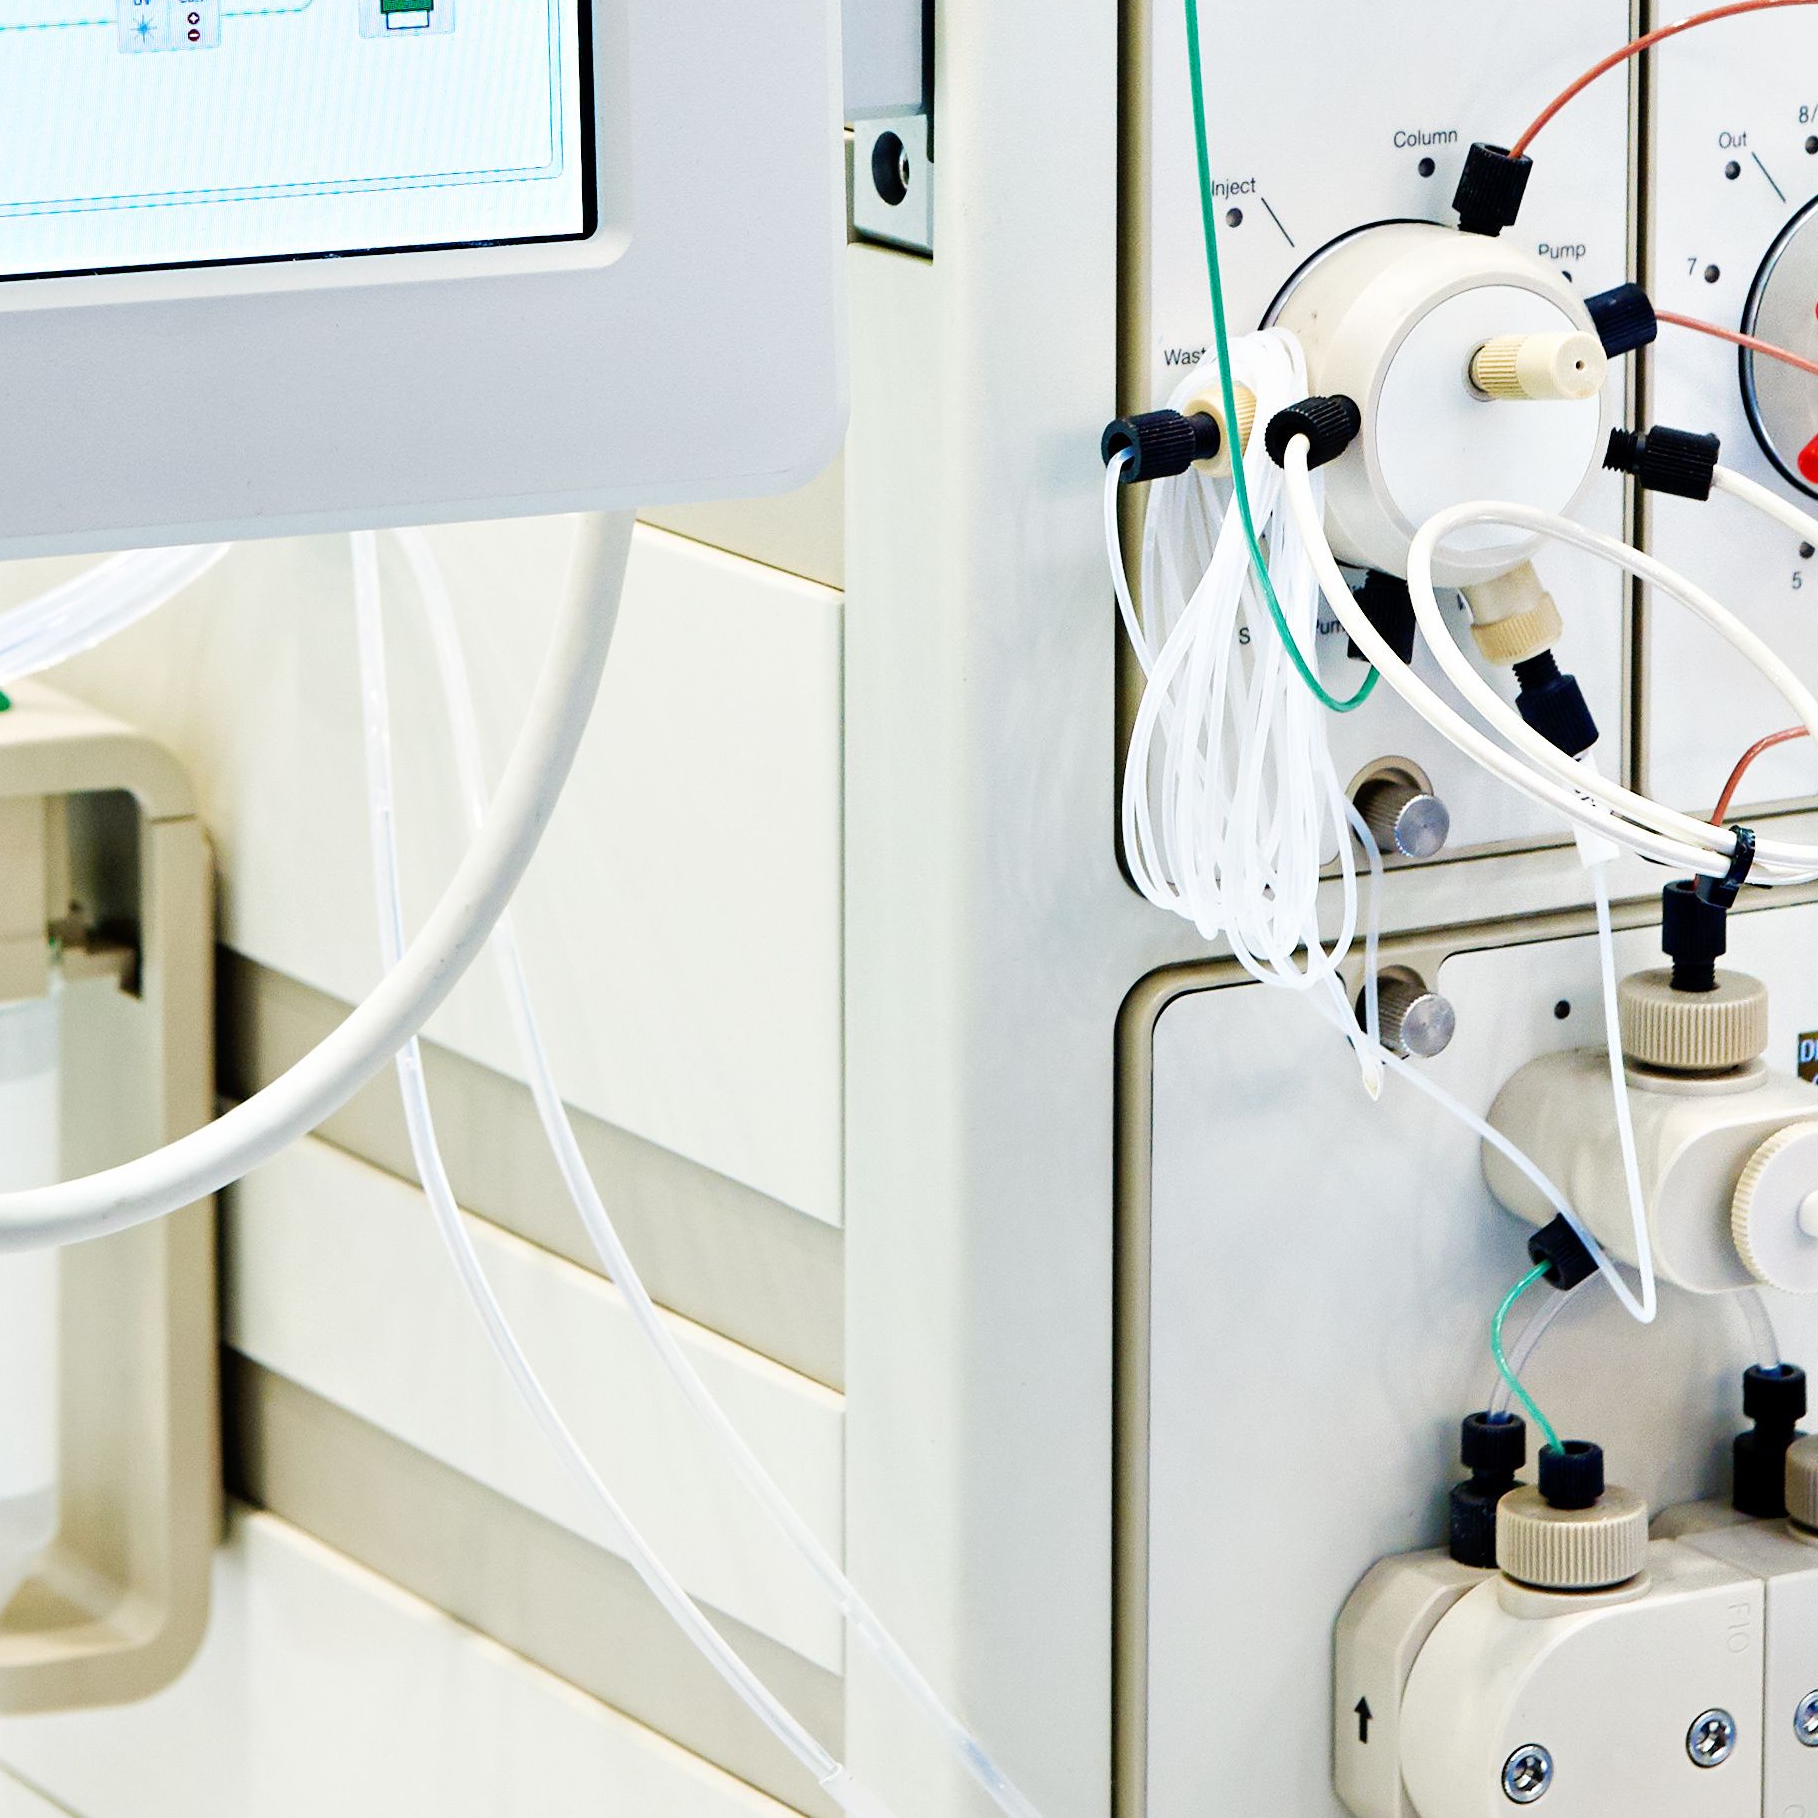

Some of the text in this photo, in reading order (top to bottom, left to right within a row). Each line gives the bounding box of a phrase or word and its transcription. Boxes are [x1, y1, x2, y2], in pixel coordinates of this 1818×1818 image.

[1393, 129, 1458, 149] Column
[1718, 131, 1747, 149] Out
[1211, 177, 1256, 200] Inject
[1538, 243, 1587, 260] Pump
[1686, 258, 1697, 276] 7
[1791, 571, 1802, 589] 5
[1726, 1602, 1752, 1654] F10
